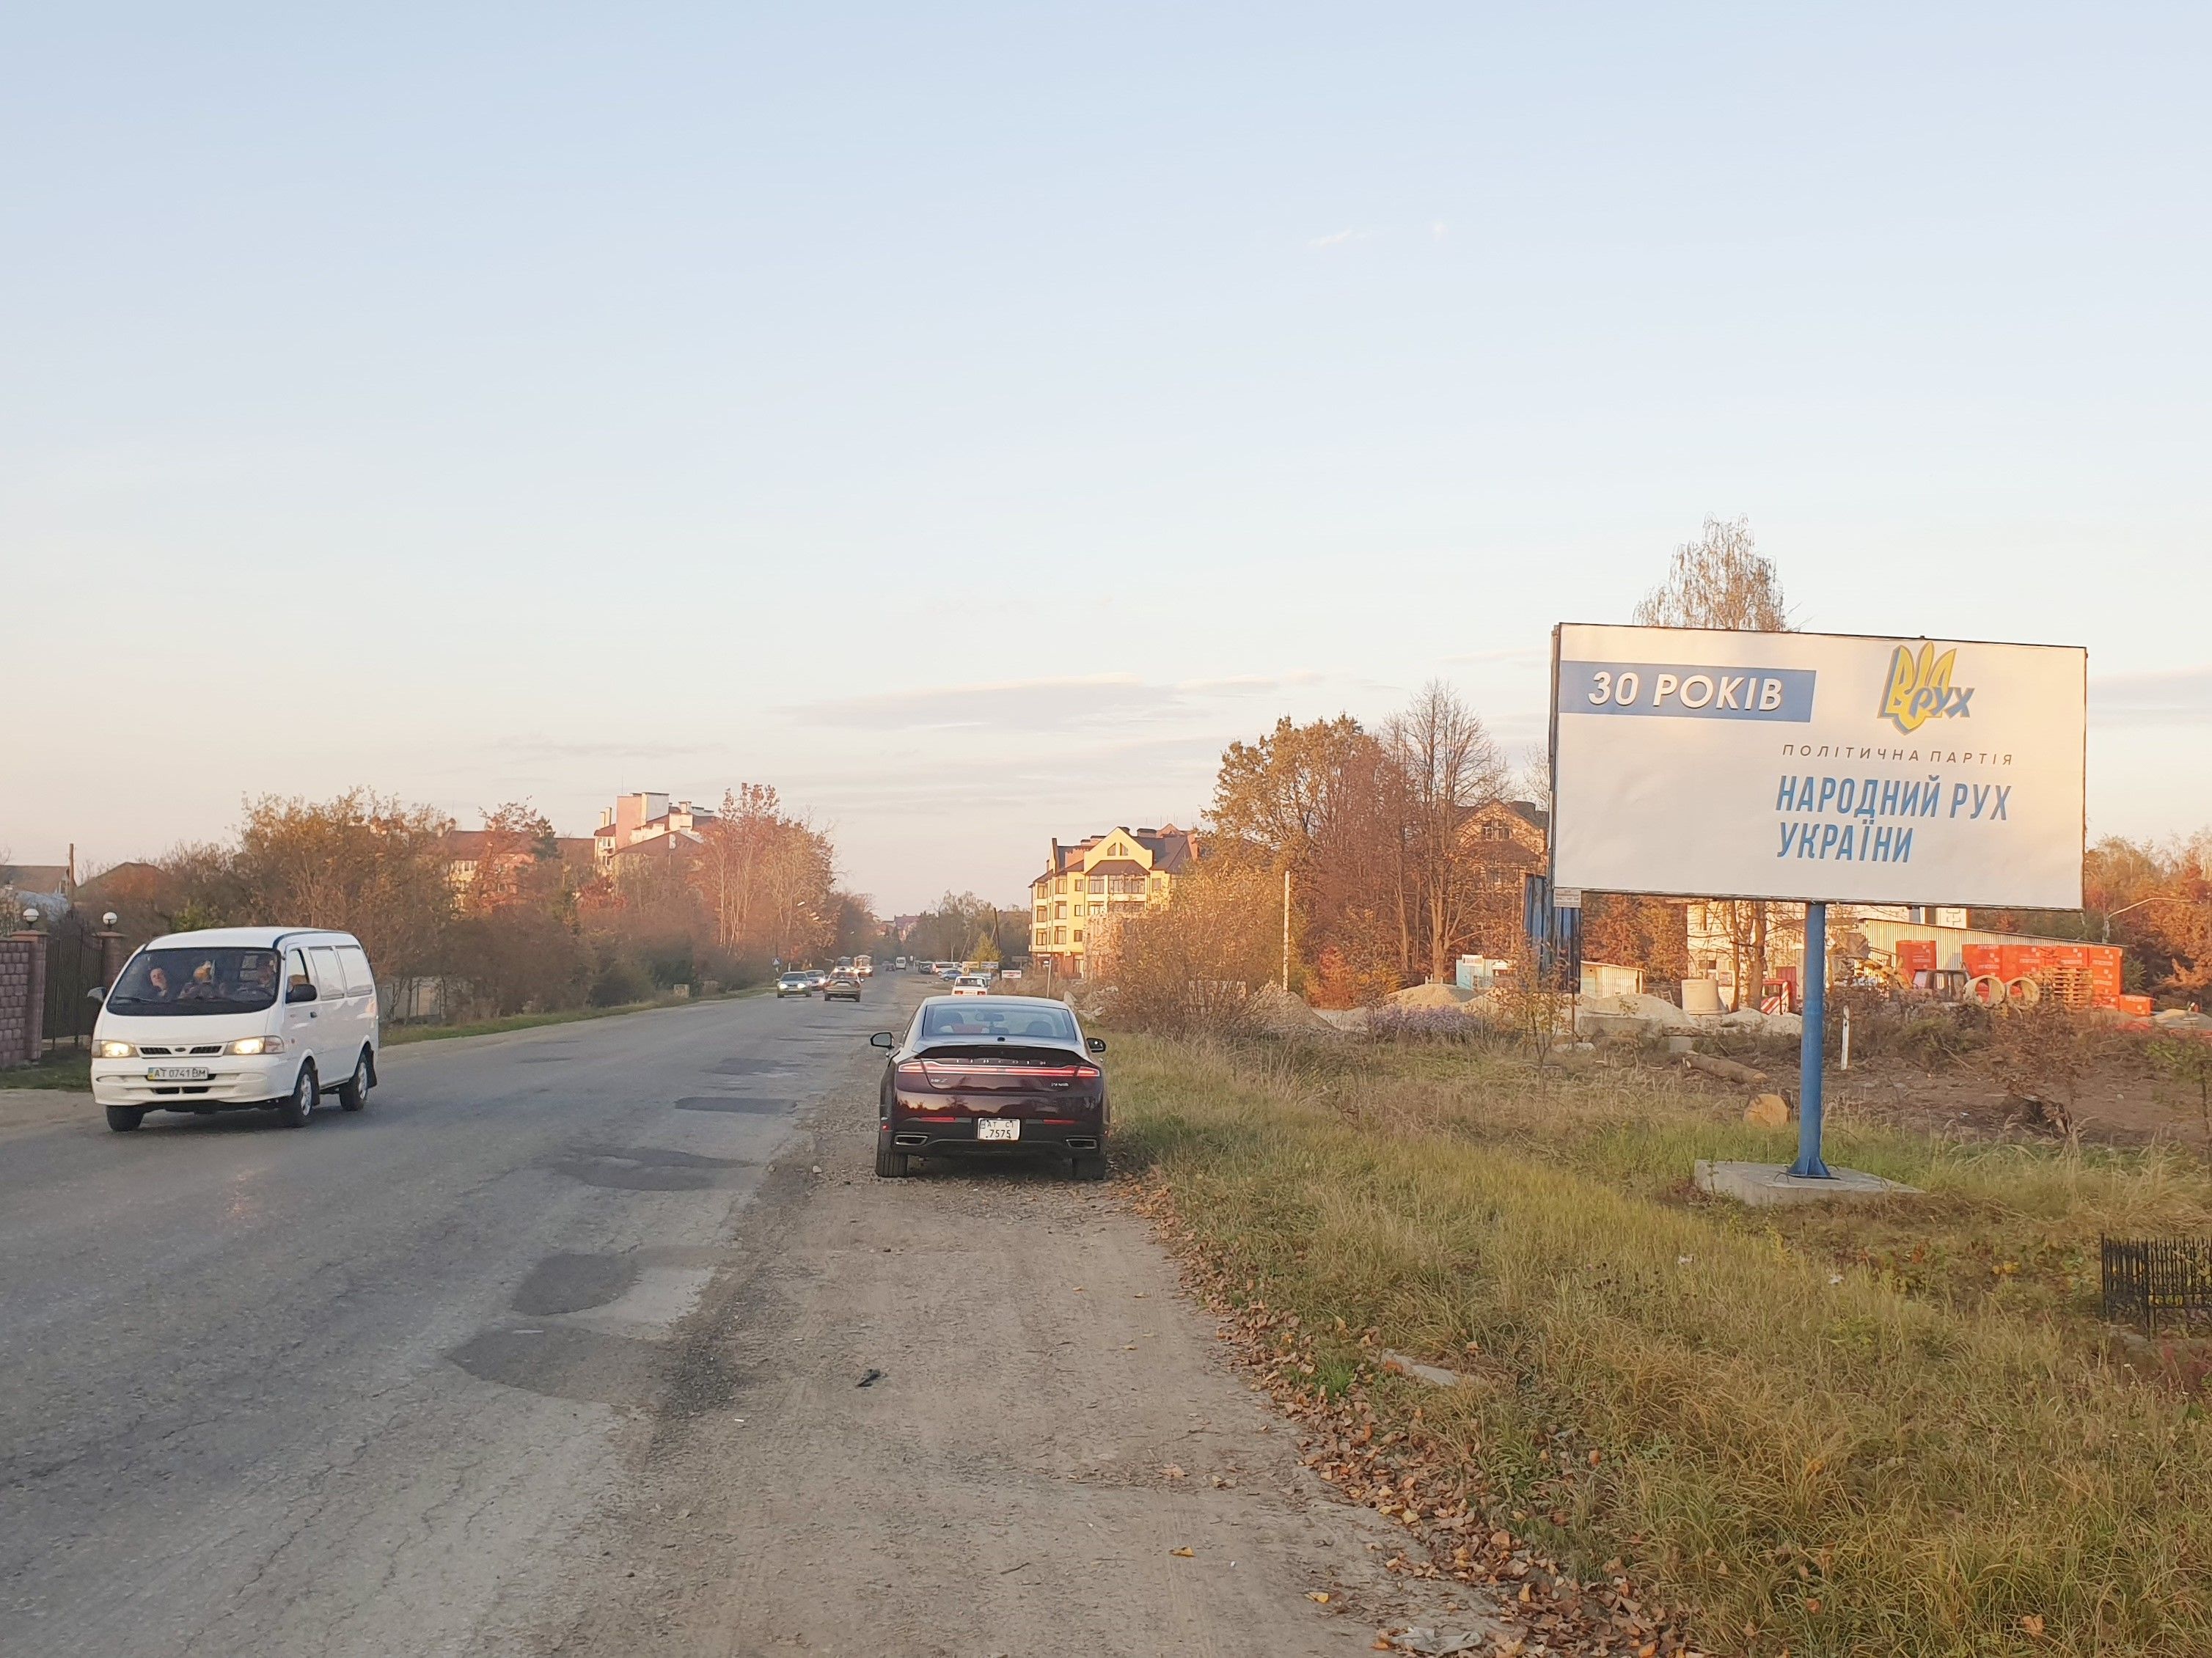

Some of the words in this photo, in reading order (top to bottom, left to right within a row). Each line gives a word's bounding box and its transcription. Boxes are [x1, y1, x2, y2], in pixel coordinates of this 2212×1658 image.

[1588, 671, 1639, 705] 30
[1652, 673, 1783, 711] РОКІВ
[1782, 744, 1919, 761] ПОЛІТИЧНА
[1930, 750, 2013, 766] ПАРТІЯ
[1775, 774, 1941, 818] НАРОДНИЙ
[1949, 782, 2012, 821] РУХ
[1776, 819, 1913, 863] УКРАЇНИ
[155, 1068, 166, 1077] AT
[169, 1069, 190, 1077] 0741
[990, 1129, 1011, 1138] 7575
